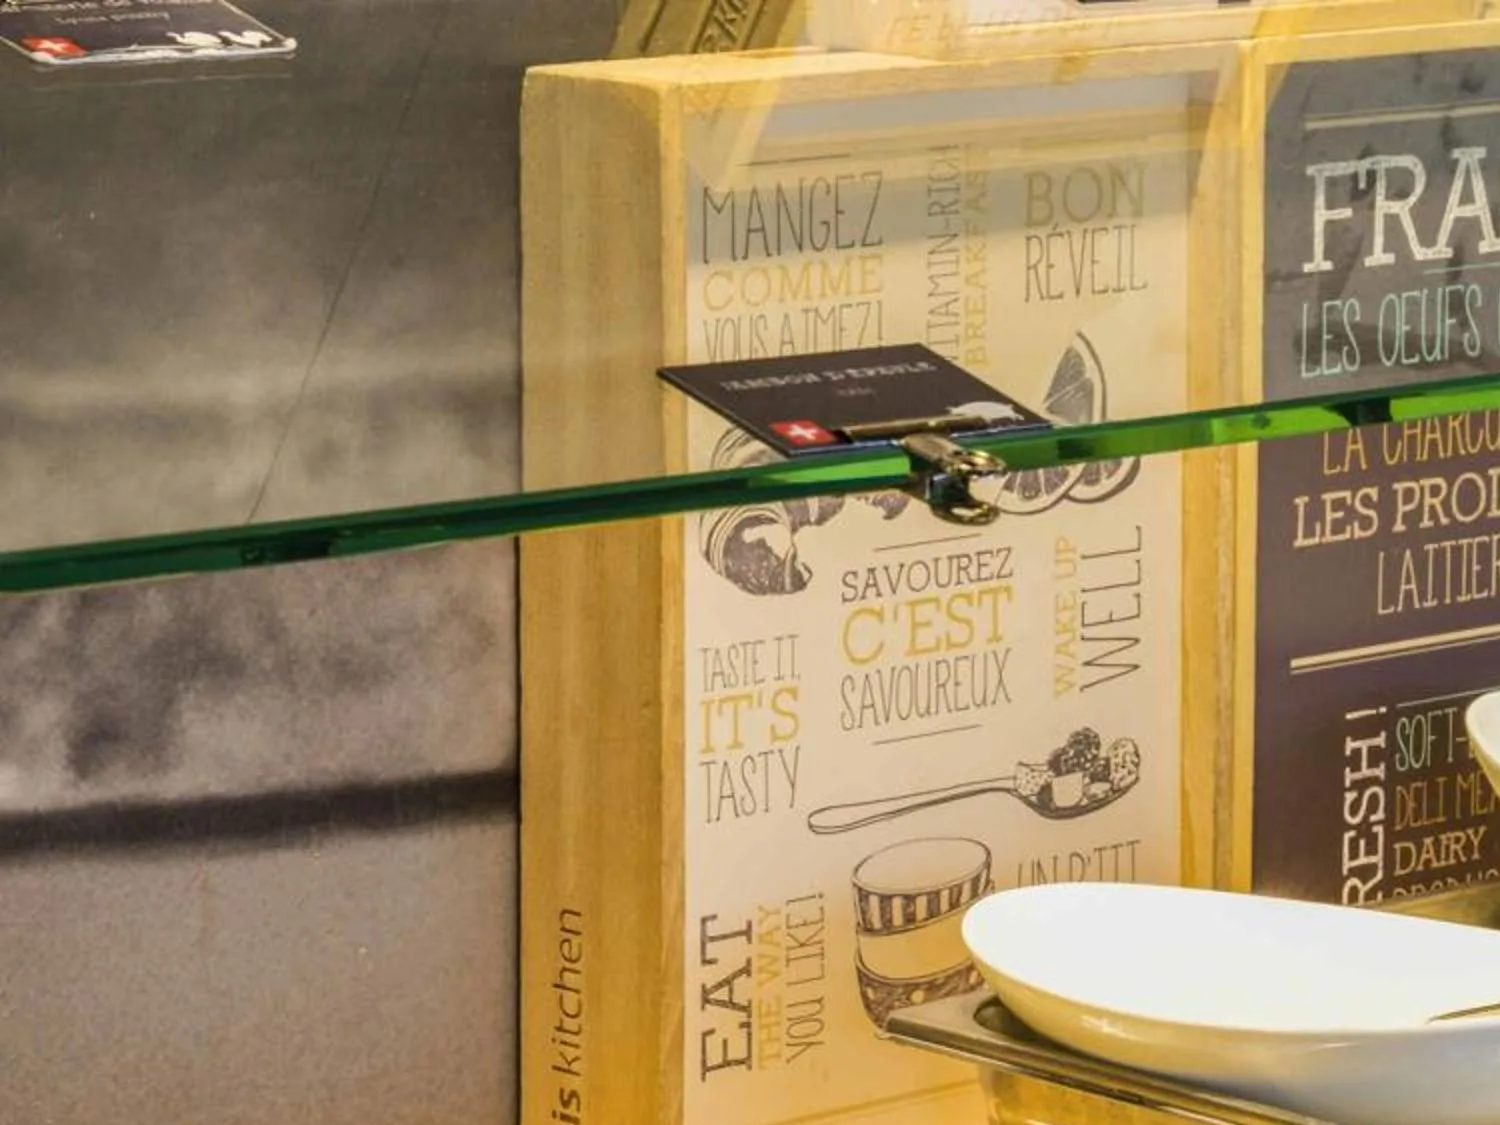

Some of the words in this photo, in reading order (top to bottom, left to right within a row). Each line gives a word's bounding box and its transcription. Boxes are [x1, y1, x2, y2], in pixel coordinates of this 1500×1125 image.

[702, 170, 884, 265] MANGEZ
[1024, 161, 1148, 227] BON
[703, 253, 885, 312] COMME
[927, 144, 960, 361] ITAMIN-RICH
[1024, 223, 1148, 303] RÉVEIL
[702, 314, 769, 362] VOUS
[1301, 299, 1361, 378] LES
[1322, 427, 1369, 475] LA
[1294, 486, 1379, 548] LES
[841, 546, 1014, 603] SAVOUREZ
[1055, 535, 1077, 579] UP
[842, 585, 1013, 667] C'EST
[1055, 590, 1077, 698] WAKE
[1079, 525, 1142, 692] WELL
[699, 640, 766, 693] TASTE
[840, 647, 1012, 731] SAVOUREUX
[700, 686, 800, 755] IT'S
[699, 746, 800, 824] TASTY
[1395, 776, 1448, 830] DELI
[1394, 825, 1488, 877] DAIRY
[757, 904, 782, 987] WAY
[786, 892, 826, 988] LIKE!
[552, 907, 584, 1076] kitchen
[700, 913, 753, 1083] EAT
[758, 995, 782, 1071] THE
[786, 996, 826, 1066] YOU
